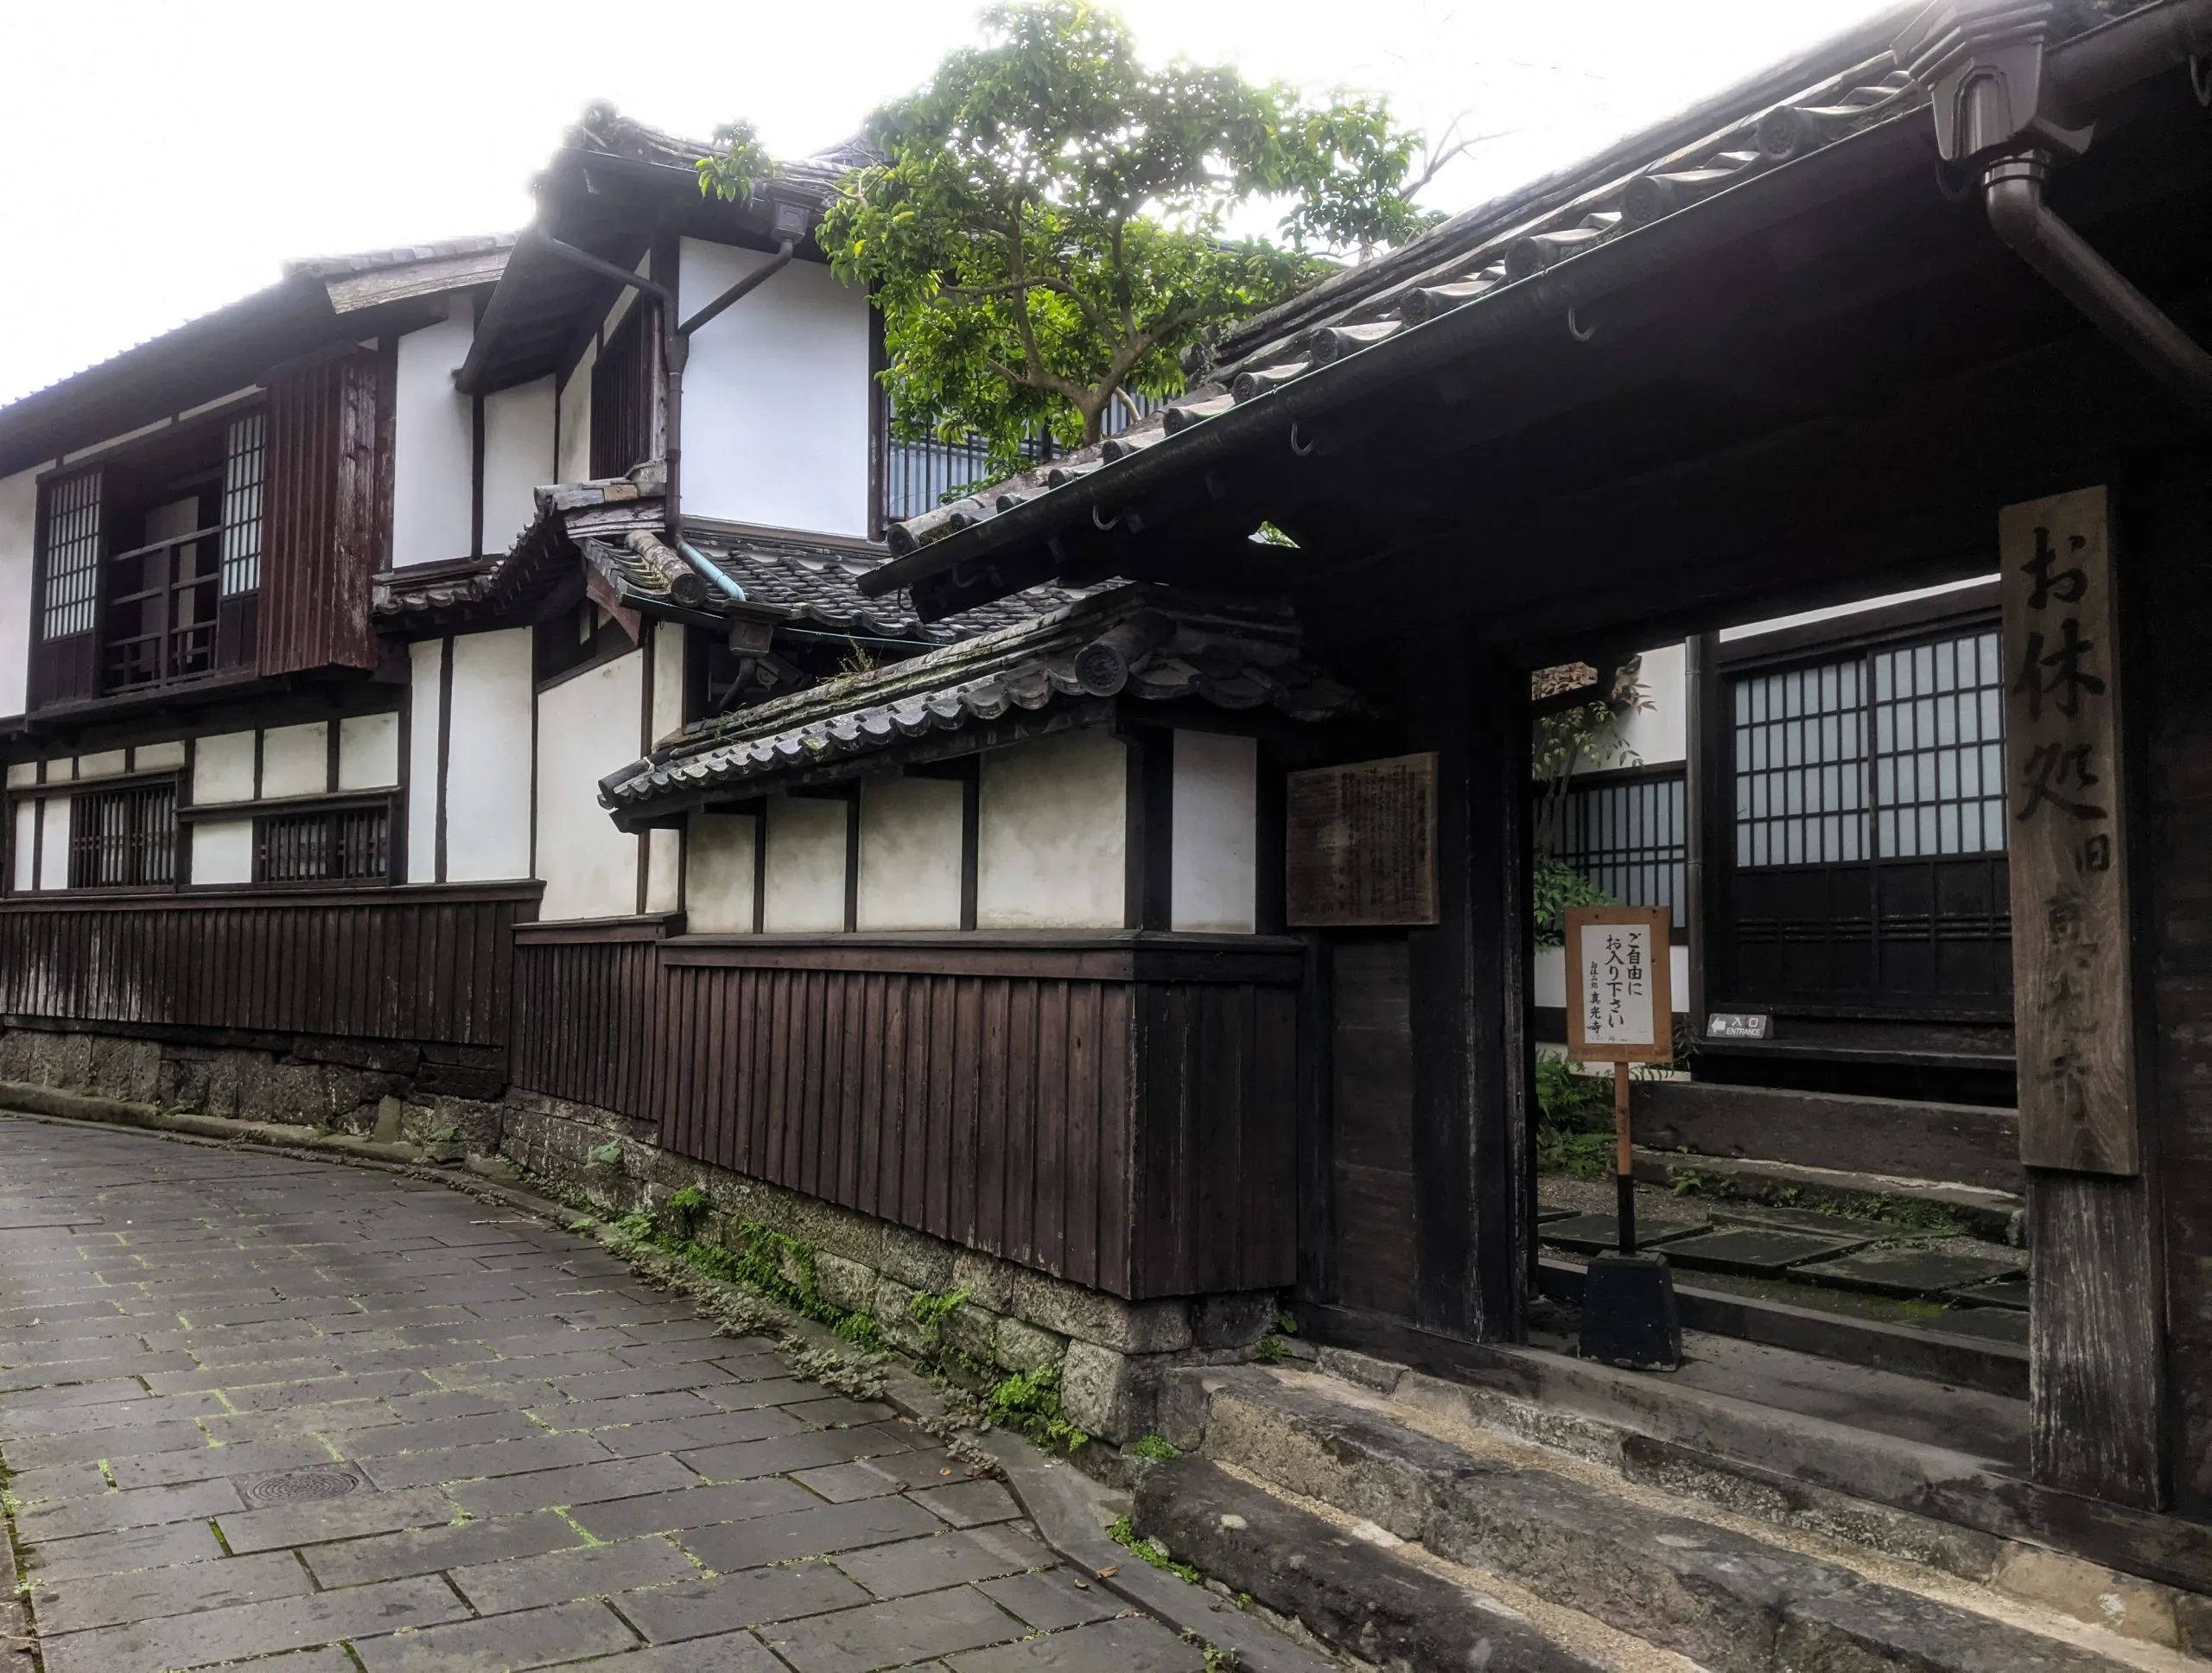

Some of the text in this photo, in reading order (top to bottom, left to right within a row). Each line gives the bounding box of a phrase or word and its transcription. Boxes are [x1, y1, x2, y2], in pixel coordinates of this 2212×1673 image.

[1605, 934, 1624, 1028] お入り下さい
[1626, 932, 1643, 996] ご自由に
[1586, 991, 1602, 1034] 真光寺
[1726, 1027, 1761, 1036] ENTRANCE
[1732, 1017, 1759, 1027] 入口
